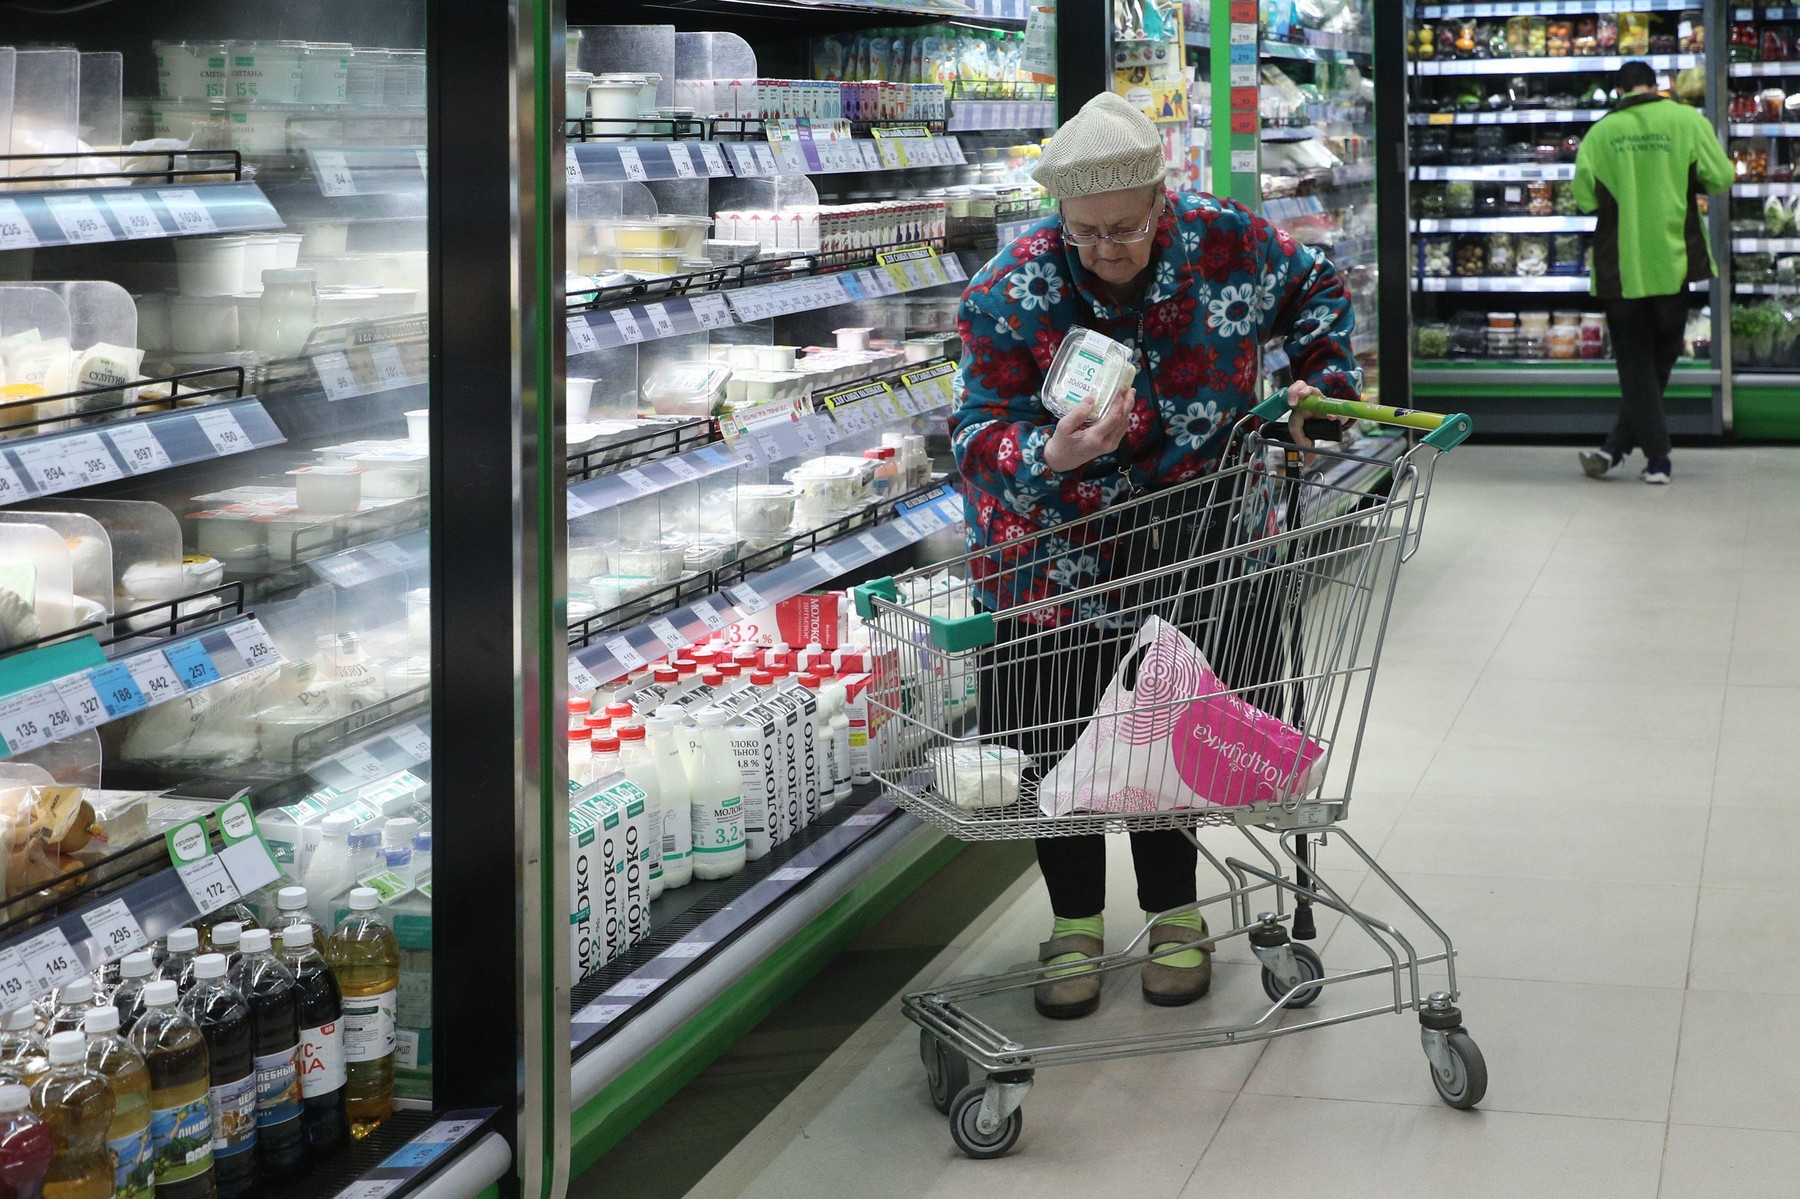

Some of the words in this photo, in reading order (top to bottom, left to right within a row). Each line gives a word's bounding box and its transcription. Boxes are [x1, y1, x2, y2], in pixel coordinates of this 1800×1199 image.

[77, 218, 98, 232] 895
[130, 215, 149, 228] 850
[178, 210, 202, 224] 1030
[1, 223, 21, 236] 235
[89, 371, 126, 385] СУЛУГУНИ
[1068, 378, 1091, 392] ТВОРОГ
[219, 430, 238, 444] 160
[133, 446, 152, 460] 897
[43, 465, 66, 480] 894
[85, 457, 107, 473] 395
[810, 598, 820, 644] МОЛОКО
[762, 634, 773, 644] %
[250, 642, 268, 658] 255
[188, 663, 206, 680] 257
[149, 676, 169, 692] 842
[112, 686, 132, 703] 188
[80, 697, 100, 714] 327
[49, 710, 70, 726] 258
[16, 721, 38, 738] 135
[730, 740, 759, 748] ЛОКО
[804, 721, 816, 823] МОЛОКО
[786, 732, 798, 836] МОЛОКО
[764, 743, 778, 849] МОЛОКО
[716, 825, 738, 845] 3,2
[206, 881, 225, 899] 172
[626, 825, 641, 949] МОЛОКО
[603, 838, 617, 963] МОЛОКО
[577, 854, 591, 983] МОЛОКО
[109, 926, 131, 944] 295
[46, 956, 68, 975] 145
[0, 978, 22, 996] 153
[257, 1061, 297, 1082] ЛЕБНЫЙ
[178, 1117, 211, 1139] ЛИМОН
